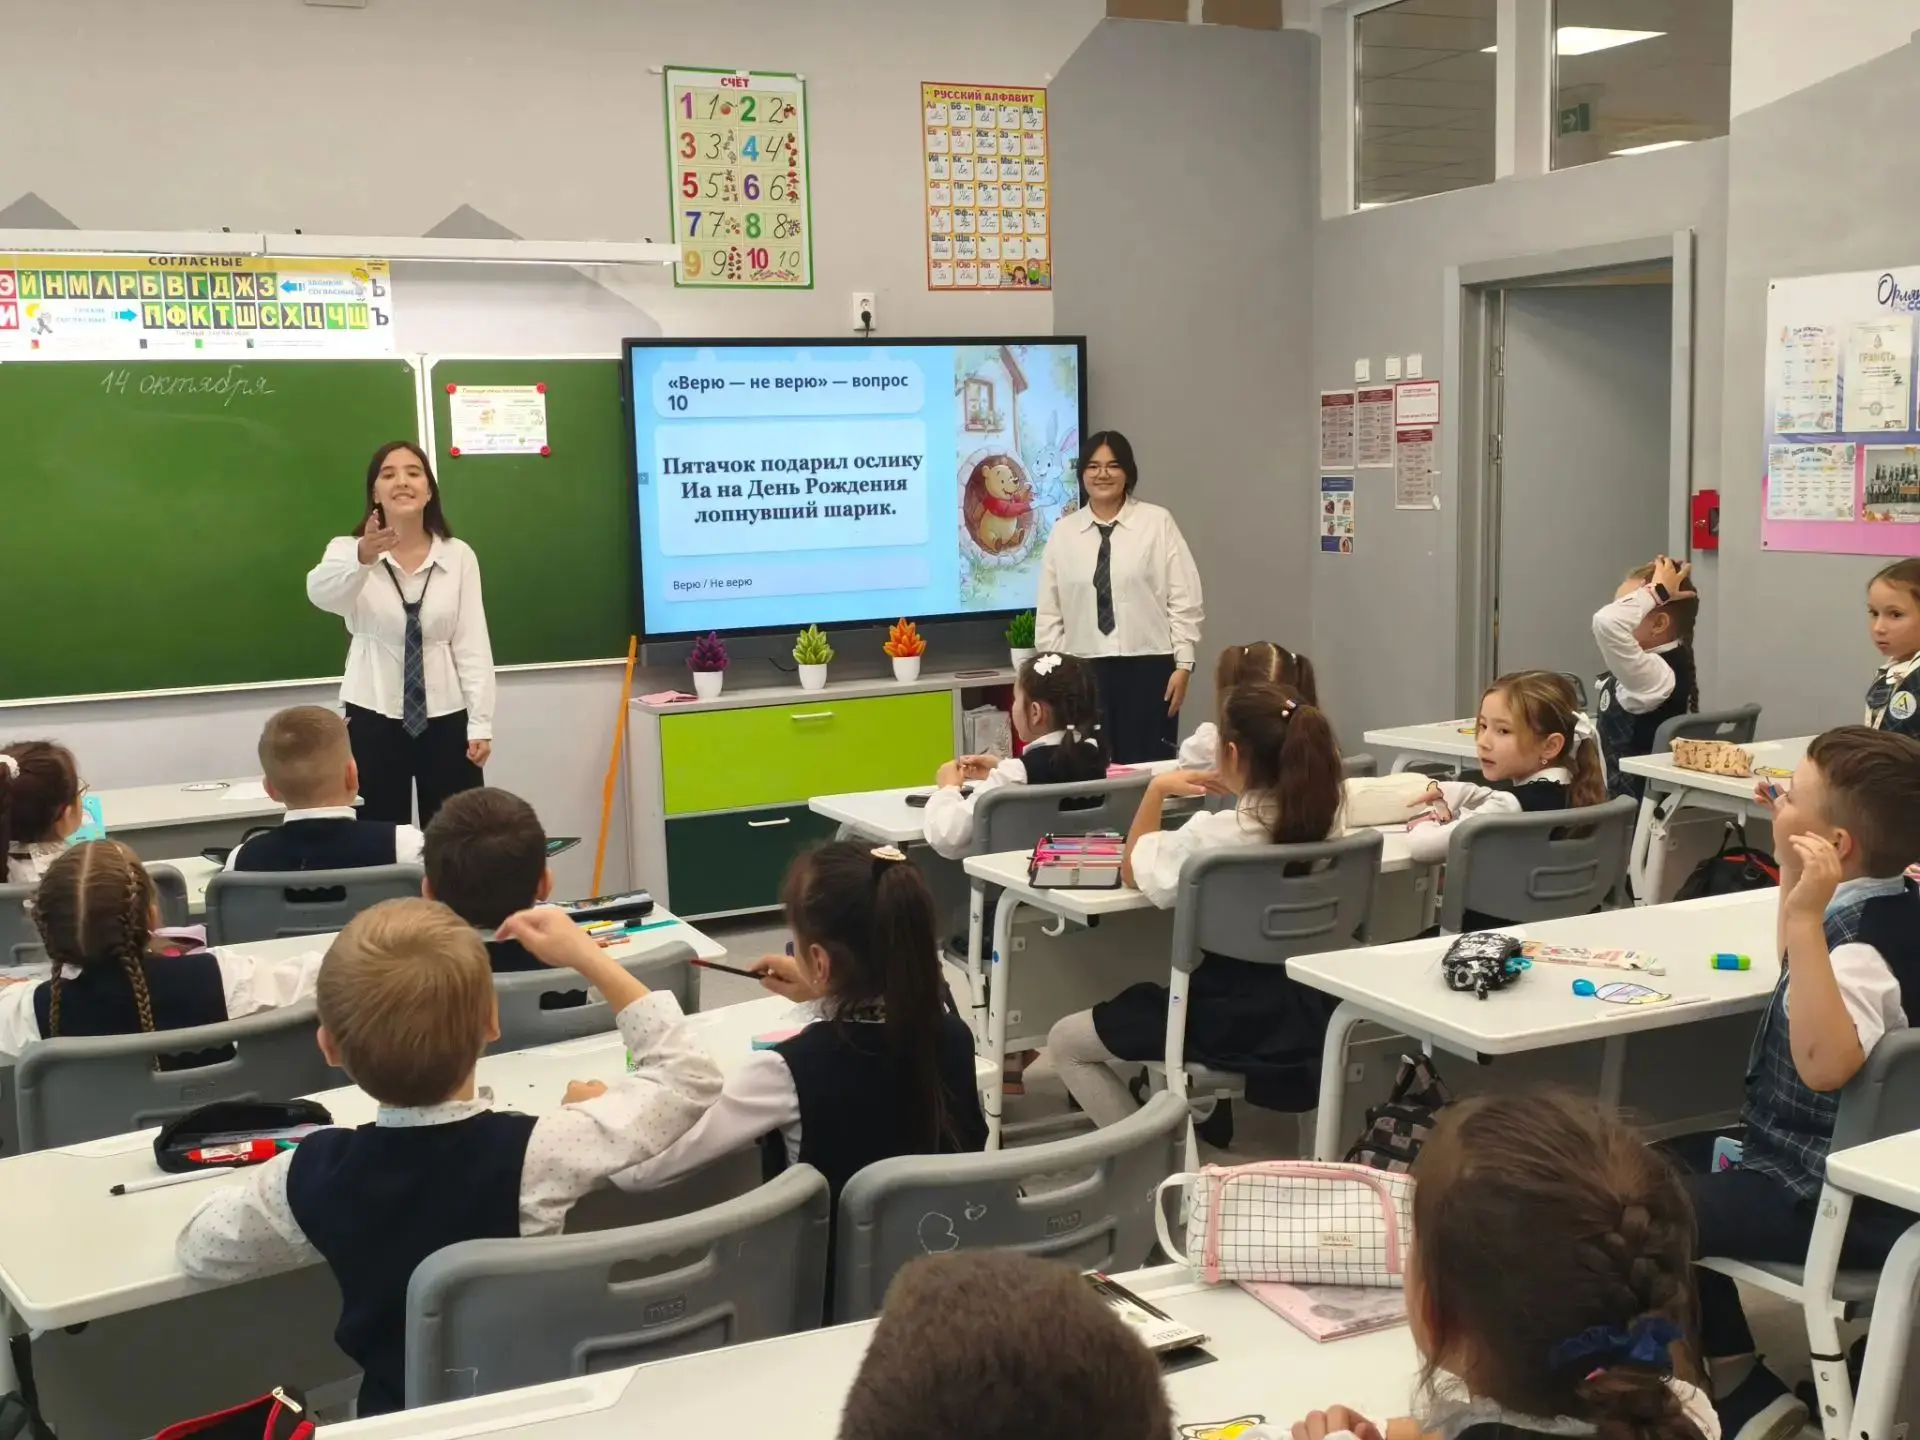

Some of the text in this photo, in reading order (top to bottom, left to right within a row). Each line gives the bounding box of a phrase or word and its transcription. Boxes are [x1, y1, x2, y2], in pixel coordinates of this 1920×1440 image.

[680, 92, 783, 123] 1 1 2 2
[933, 89, 1035, 103] РУССКИЙ АЛФАВИТ
[680, 132, 784, 162] 3 3 4 4
[682, 172, 786, 200] 5 5 6 6
[685, 211, 788, 239] 7 7 8 8
[148, 256, 242, 267] СОГЛАСНЫЕ
[684, 247, 800, 277] 9 9 10 10
[21, 271, 275, 299] Й Н М Л Р Б В Г Д Ж З
[146, 305, 162, 326] П
[167, 304, 186, 327] Ф
[192, 306, 209, 326] К
[214, 306, 230, 326] Т
[236, 305, 256, 326] Ш
[260, 305, 277, 327] С
[283, 306, 301, 326] Х
[305, 306, 324, 328] Ц
[328, 306, 344, 326] Ч
[100, 364, 276, 407] 14 октября
[668, 376, 725, 394] «Верю
[750, 377, 770, 389] не
[775, 377, 828, 392] верю»
[852, 376, 909, 391] вопрос
[668, 395, 688, 411] 10
[663, 454, 923, 475] Пятачок подарил ослику
[681, 478, 908, 500] Иа на День Рождения
[694, 500, 896, 525] лопнувший шарик.
[673, 580, 700, 592] Верю
[710, 579, 724, 588] Не
[726, 578, 753, 589] верю
